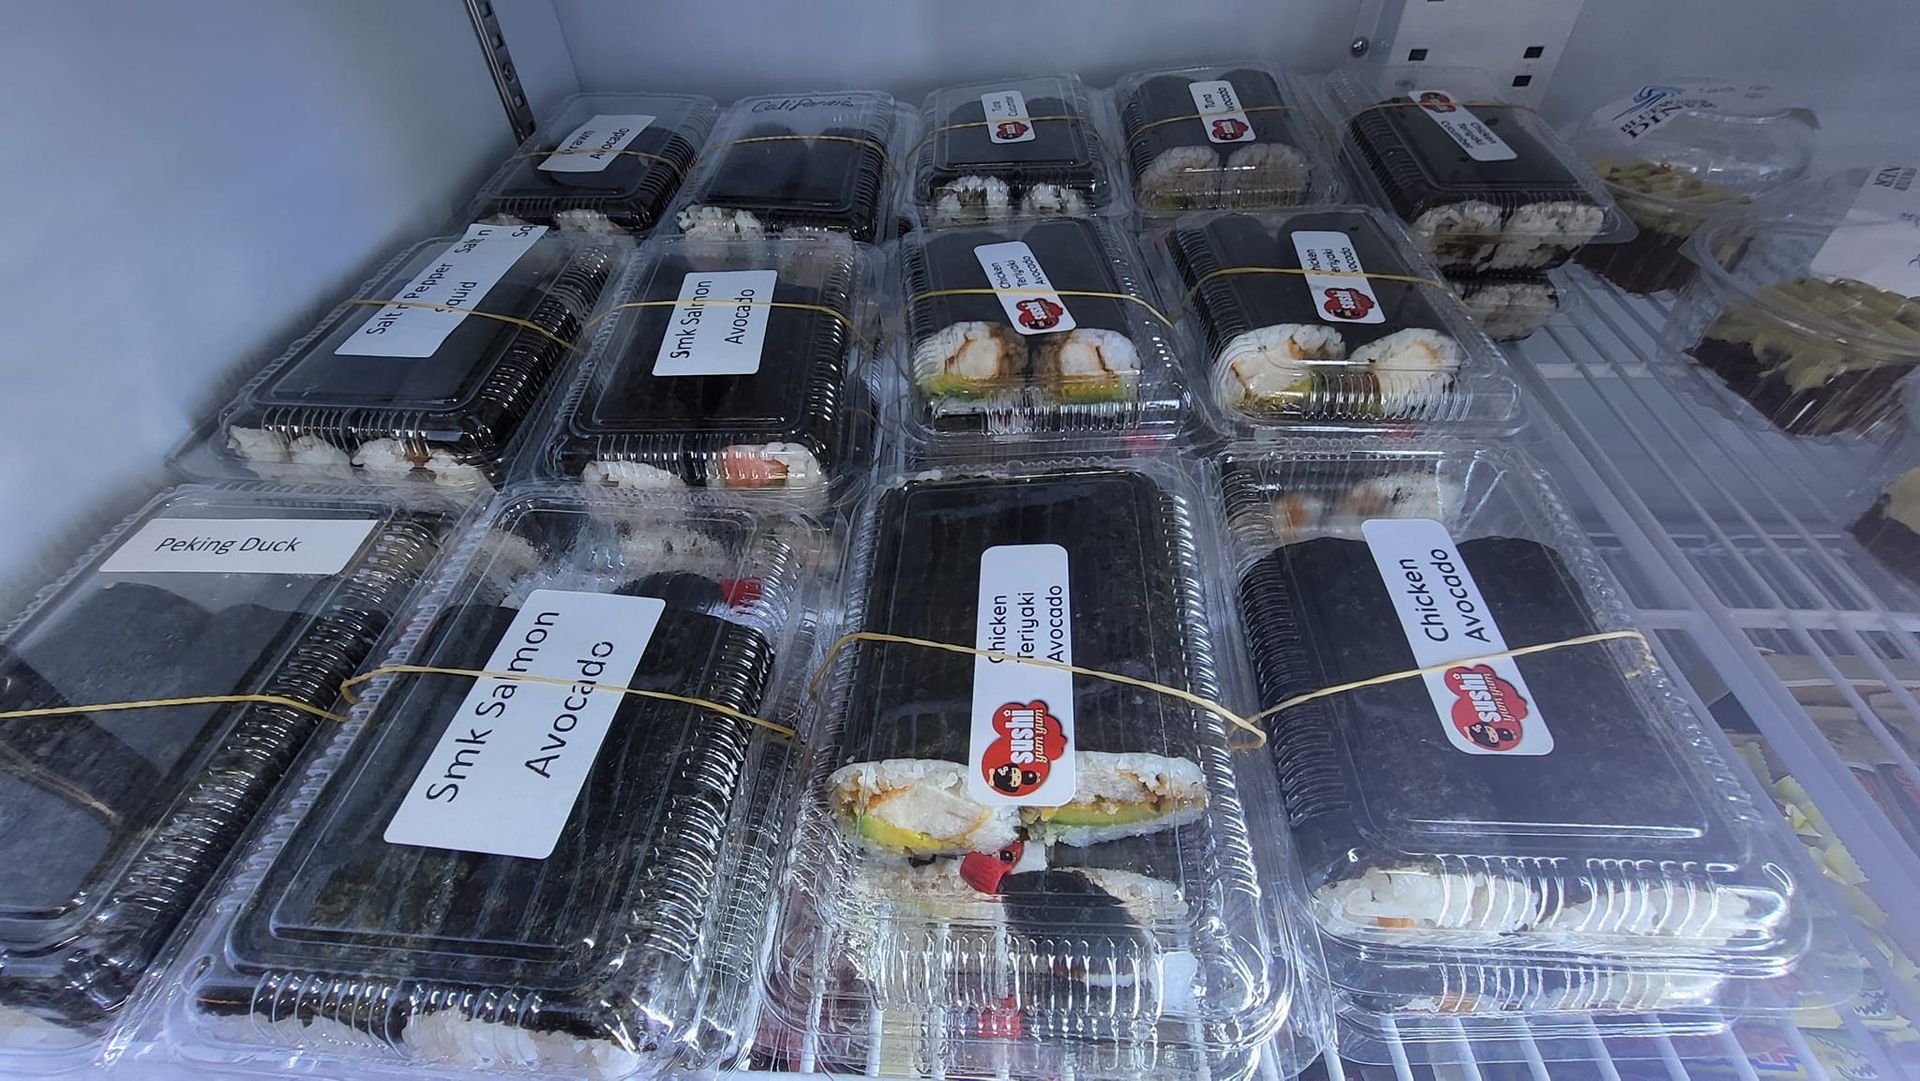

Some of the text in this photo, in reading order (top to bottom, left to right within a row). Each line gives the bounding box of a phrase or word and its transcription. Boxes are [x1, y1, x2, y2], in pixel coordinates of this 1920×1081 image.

[1217, 86, 1235, 112] vocado
[366, 311, 401, 335] Salt
[403, 263, 453, 299] Pepper
[454, 237, 486, 254] Salt
[478, 229, 493, 237] n
[991, 261, 1011, 289] Chicken
[1004, 259, 1028, 287] Teriyaki
[1022, 255, 1046, 285] Avocado
[1307, 248, 1321, 271] hicken
[1321, 248, 1341, 274] eriyaki
[1340, 246, 1358, 273] vocado
[669, 280, 712, 359] Smk Salmon
[724, 288, 755, 345] Avocado
[155, 536, 302, 555] Peking Duck
[1399, 559, 1449, 642] Chicken
[1430, 548, 1491, 643] Avocado
[987, 595, 1007, 664] Chicken
[1017, 592, 1039, 663] Teriyaki
[1045, 585, 1064, 663] Avocado
[425, 611, 560, 803] Smk Salmon
[524, 641, 614, 779] Avocado
[1452, 673, 1502, 723] sushi
[1003, 709, 1034, 764] sushi
